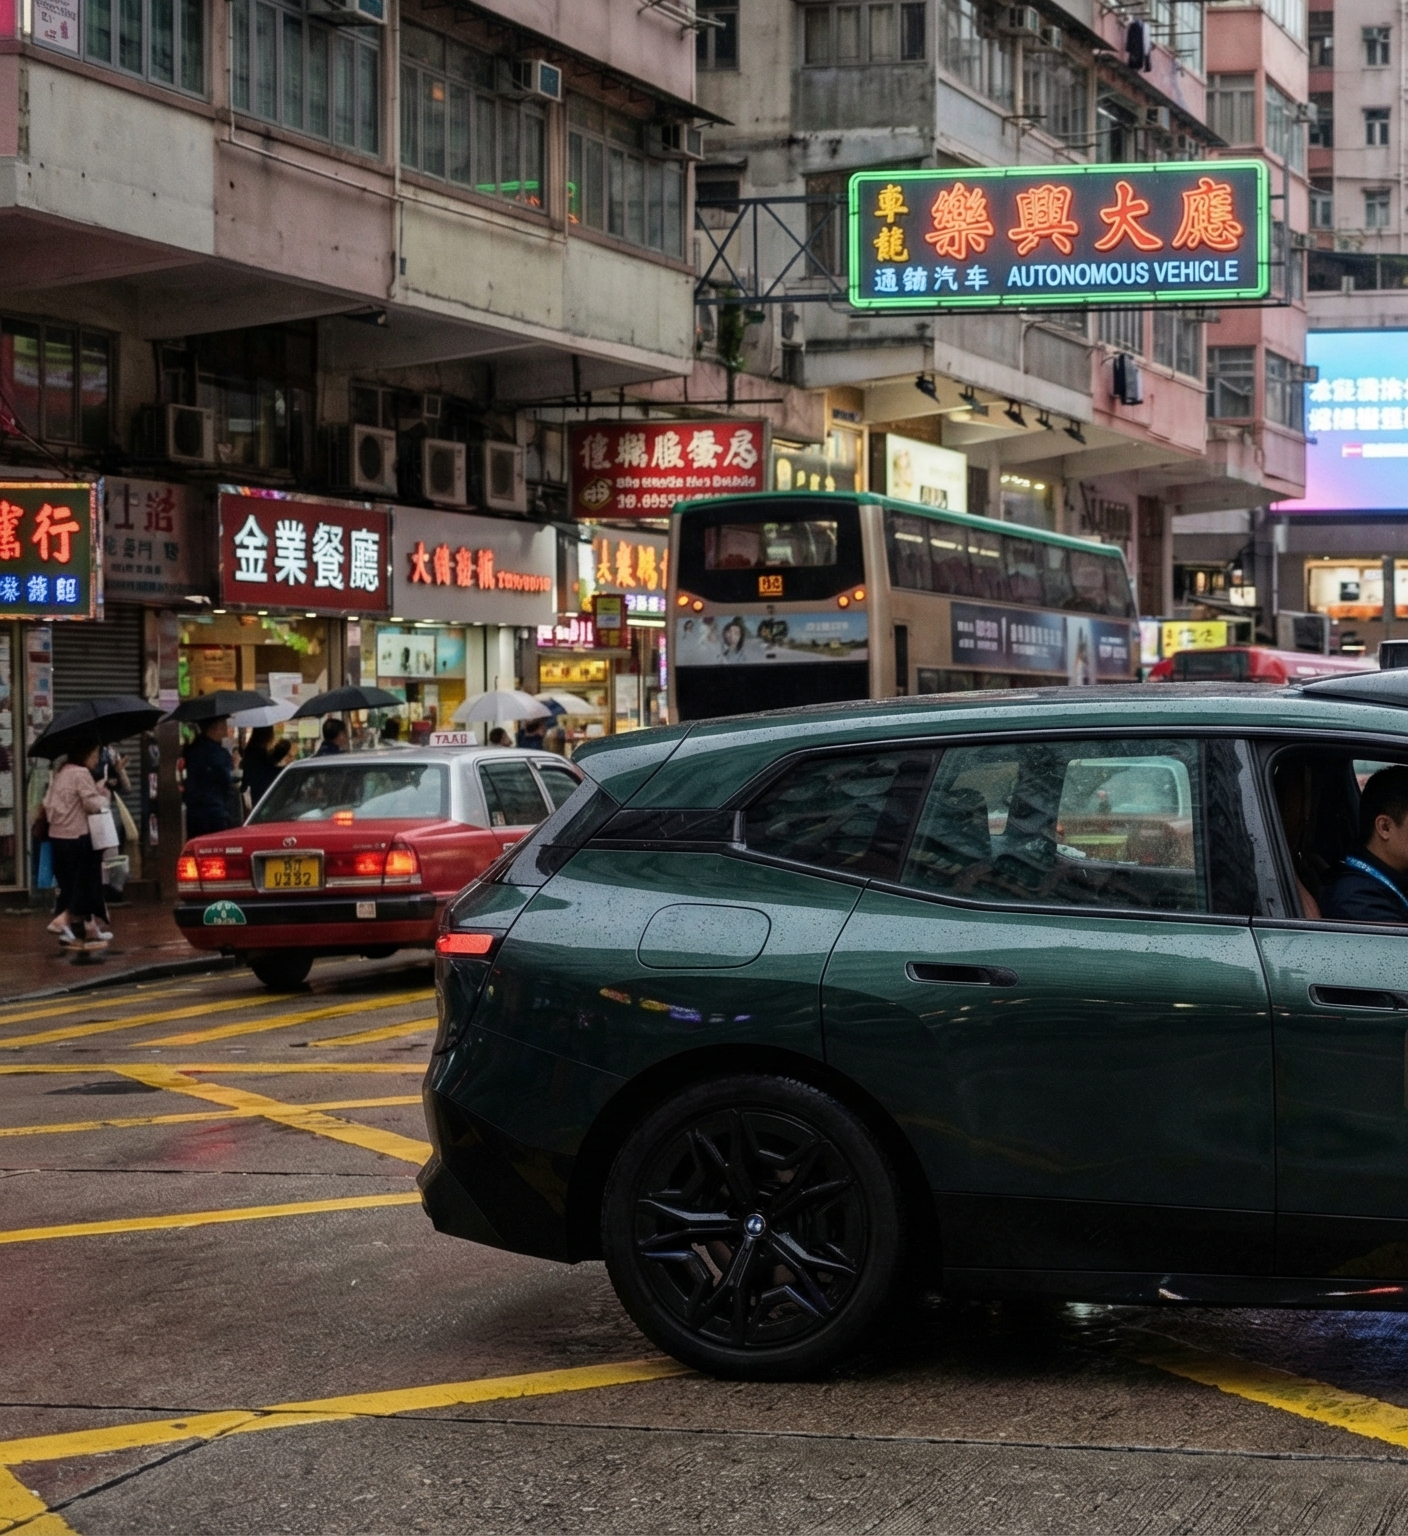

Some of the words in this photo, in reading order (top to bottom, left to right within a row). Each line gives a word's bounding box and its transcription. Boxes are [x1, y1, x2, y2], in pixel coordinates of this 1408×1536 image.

[1007, 262, 1149, 287] AUTONOMOUS
[1154, 260, 1239, 283] VEHICLE
[233, 513, 380, 592] 金業餐廳
